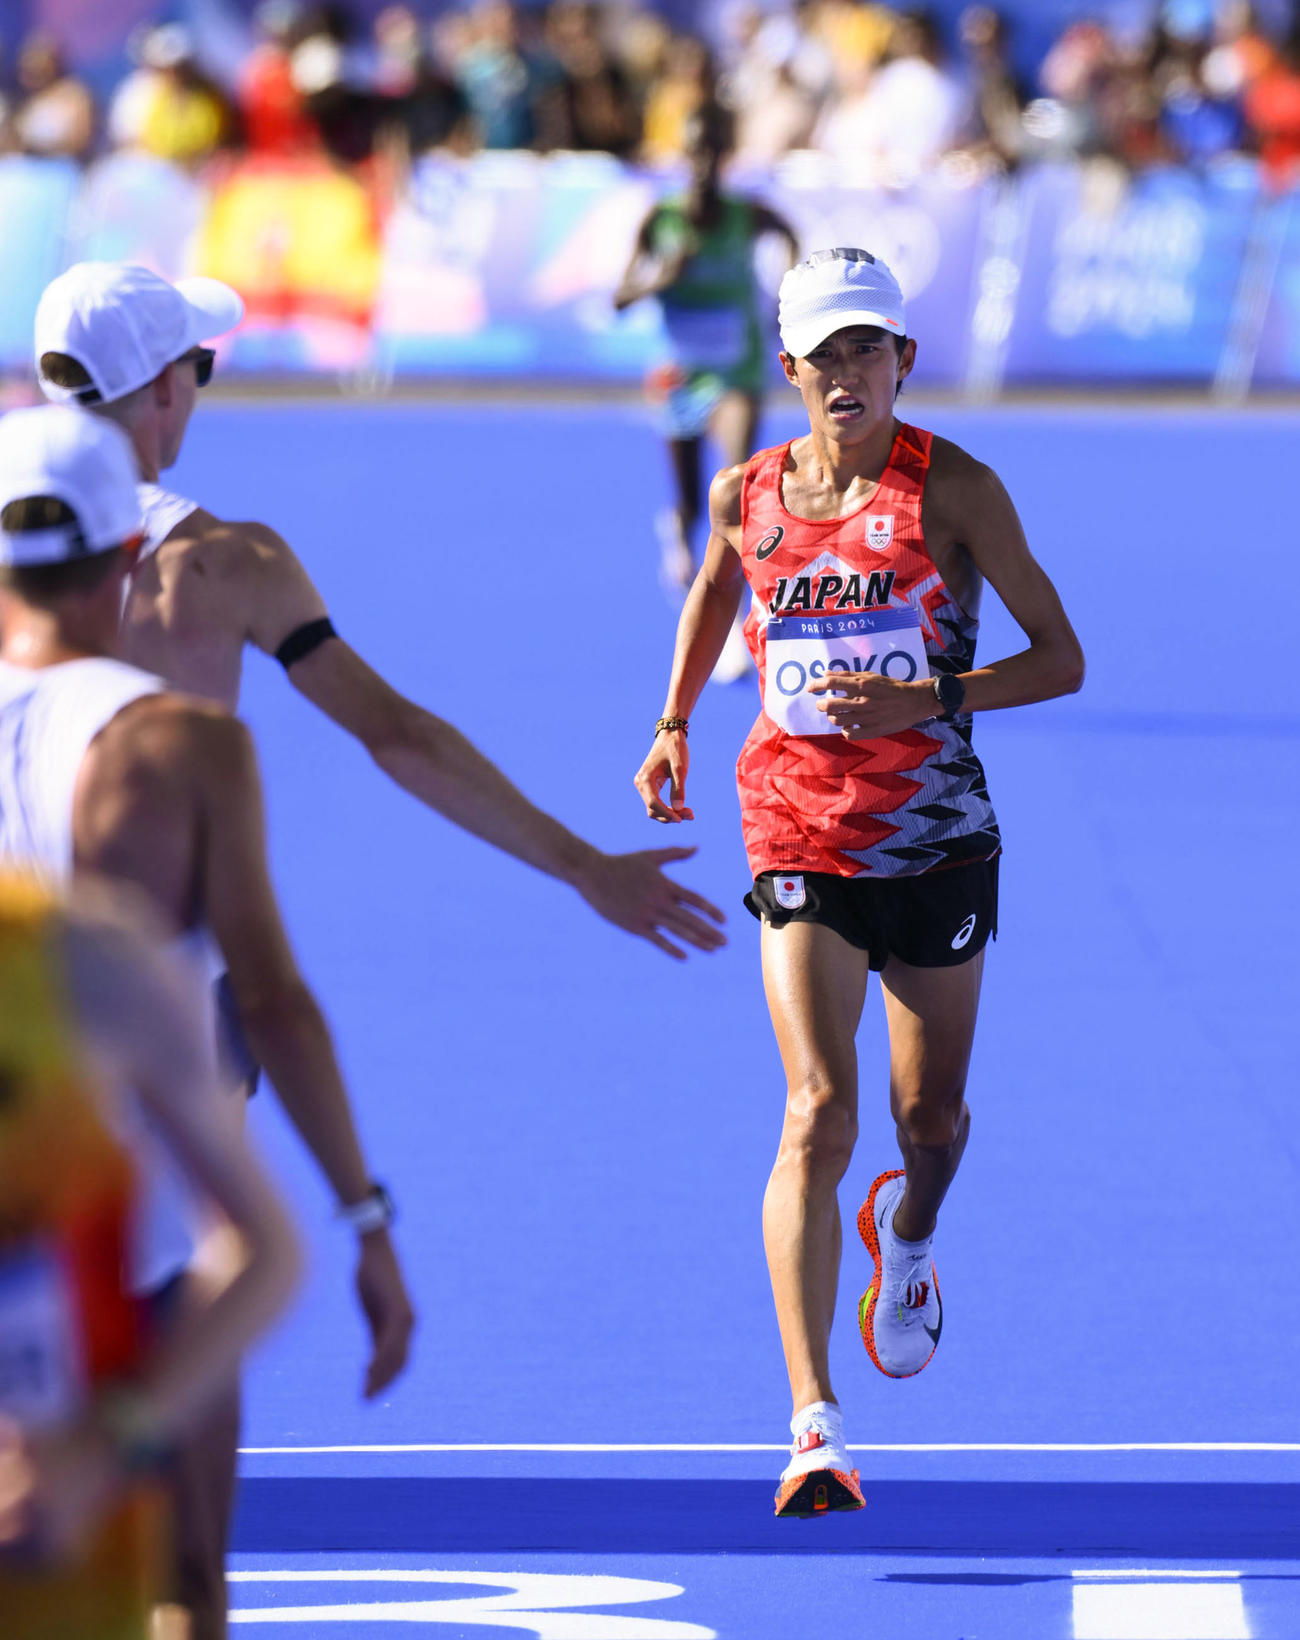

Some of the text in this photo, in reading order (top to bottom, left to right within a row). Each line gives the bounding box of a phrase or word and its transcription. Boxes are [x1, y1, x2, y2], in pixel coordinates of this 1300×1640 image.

[768, 571, 895, 614] JAPAN
[801, 618, 875, 634] PARIS 2024
